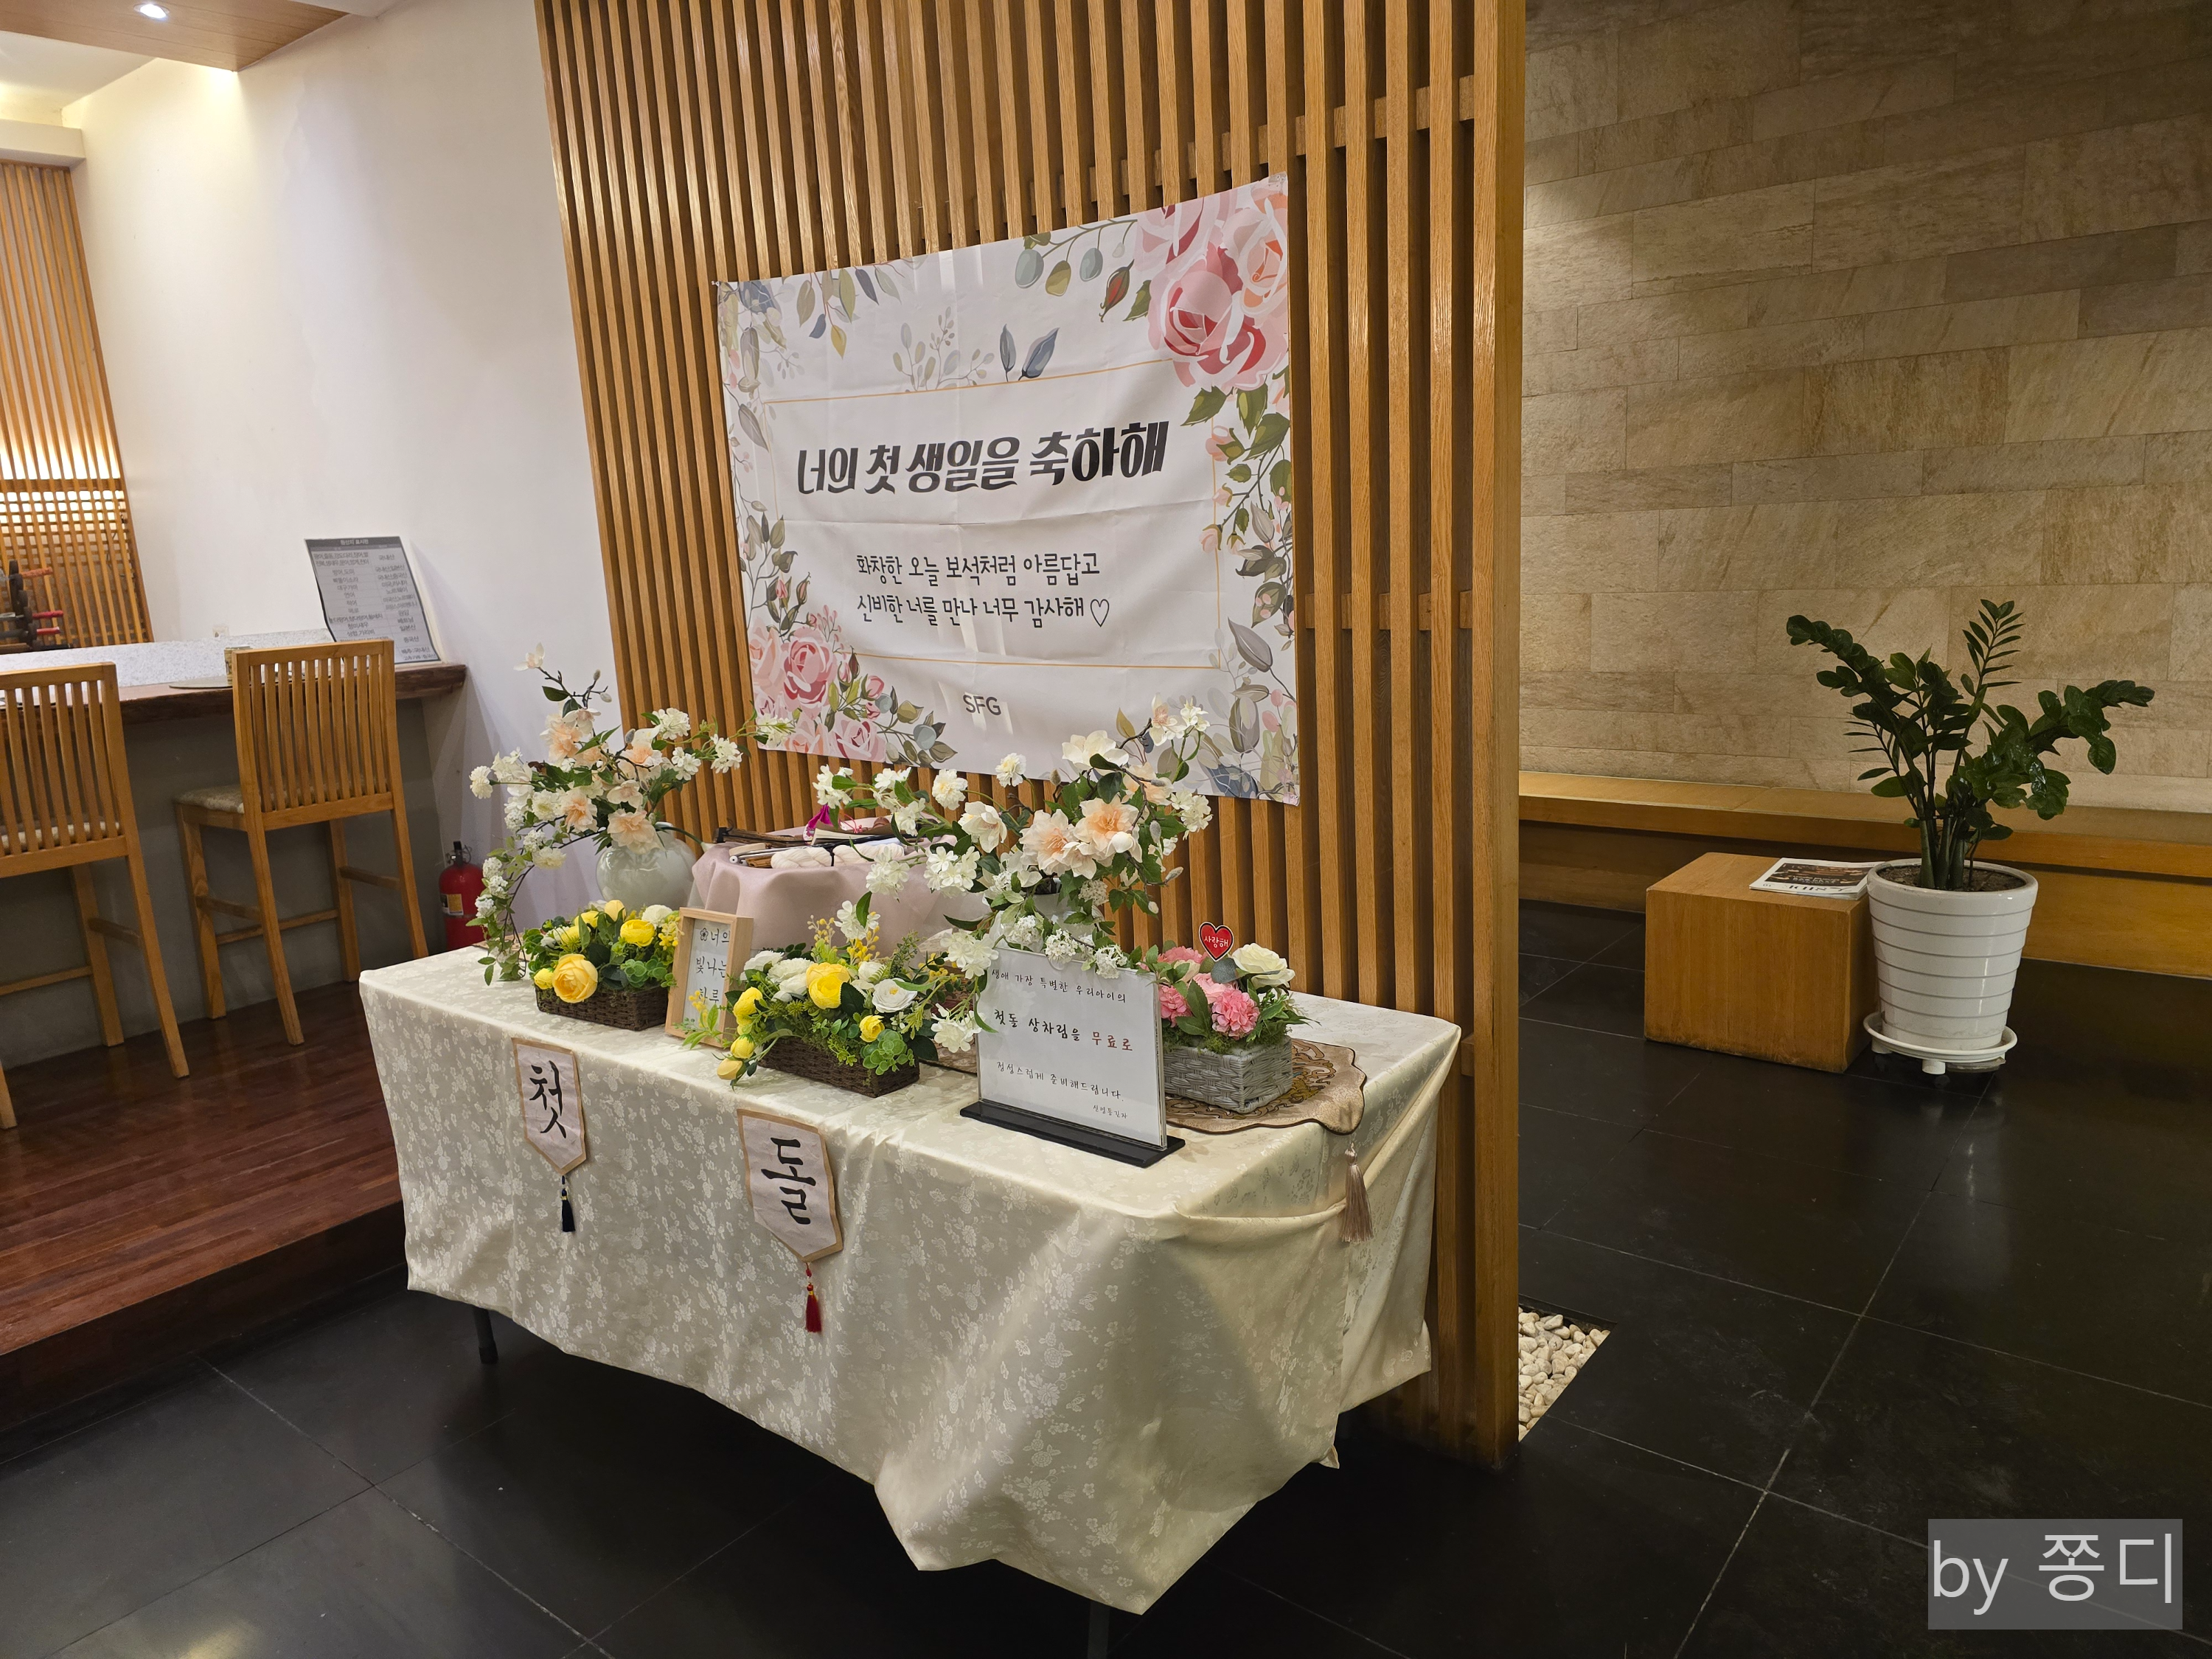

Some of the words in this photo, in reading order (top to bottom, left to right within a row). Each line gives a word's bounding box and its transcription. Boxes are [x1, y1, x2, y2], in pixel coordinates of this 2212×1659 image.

[798, 448, 858, 494] 너의
[864, 445, 900, 494] 첫
[905, 437, 1020, 493] 생일을
[1030, 421, 1169, 485] 축하해
[857, 555, 902, 584] 화창한
[909, 557, 939, 586] 오늘
[946, 555, 1015, 585] 보석처럼
[1024, 553, 1099, 585] 아름답고
[858, 594, 902, 623] 신비한
[906, 597, 938, 626] 너를
[942, 598, 978, 626] 만나
[983, 598, 1018, 622] 너무
[1024, 597, 1083, 627] 감사해
[963, 695, 1001, 715] SFG
[710, 928, 730, 947] 너의
[1204, 936, 1228, 948] 사랑해
[696, 956, 726, 978] 빛나는
[992, 970, 1008, 979] 생애
[1015, 975, 1033, 985] 가장
[1040, 978, 1067, 992] 특별한
[1077, 986, 1125, 1003] 우리아이의
[995, 1009, 1018, 1027] 첫돌
[1029, 1018, 1079, 1041] 상차림을
[1091, 1032, 1133, 1051] 무료로
[997, 1062, 1043, 1079] 정성스럽게
[1050, 1074, 1124, 1102] 준비해드립니다.
[529, 1060, 566, 1138] 첫
[761, 1138, 816, 1225] 돌
